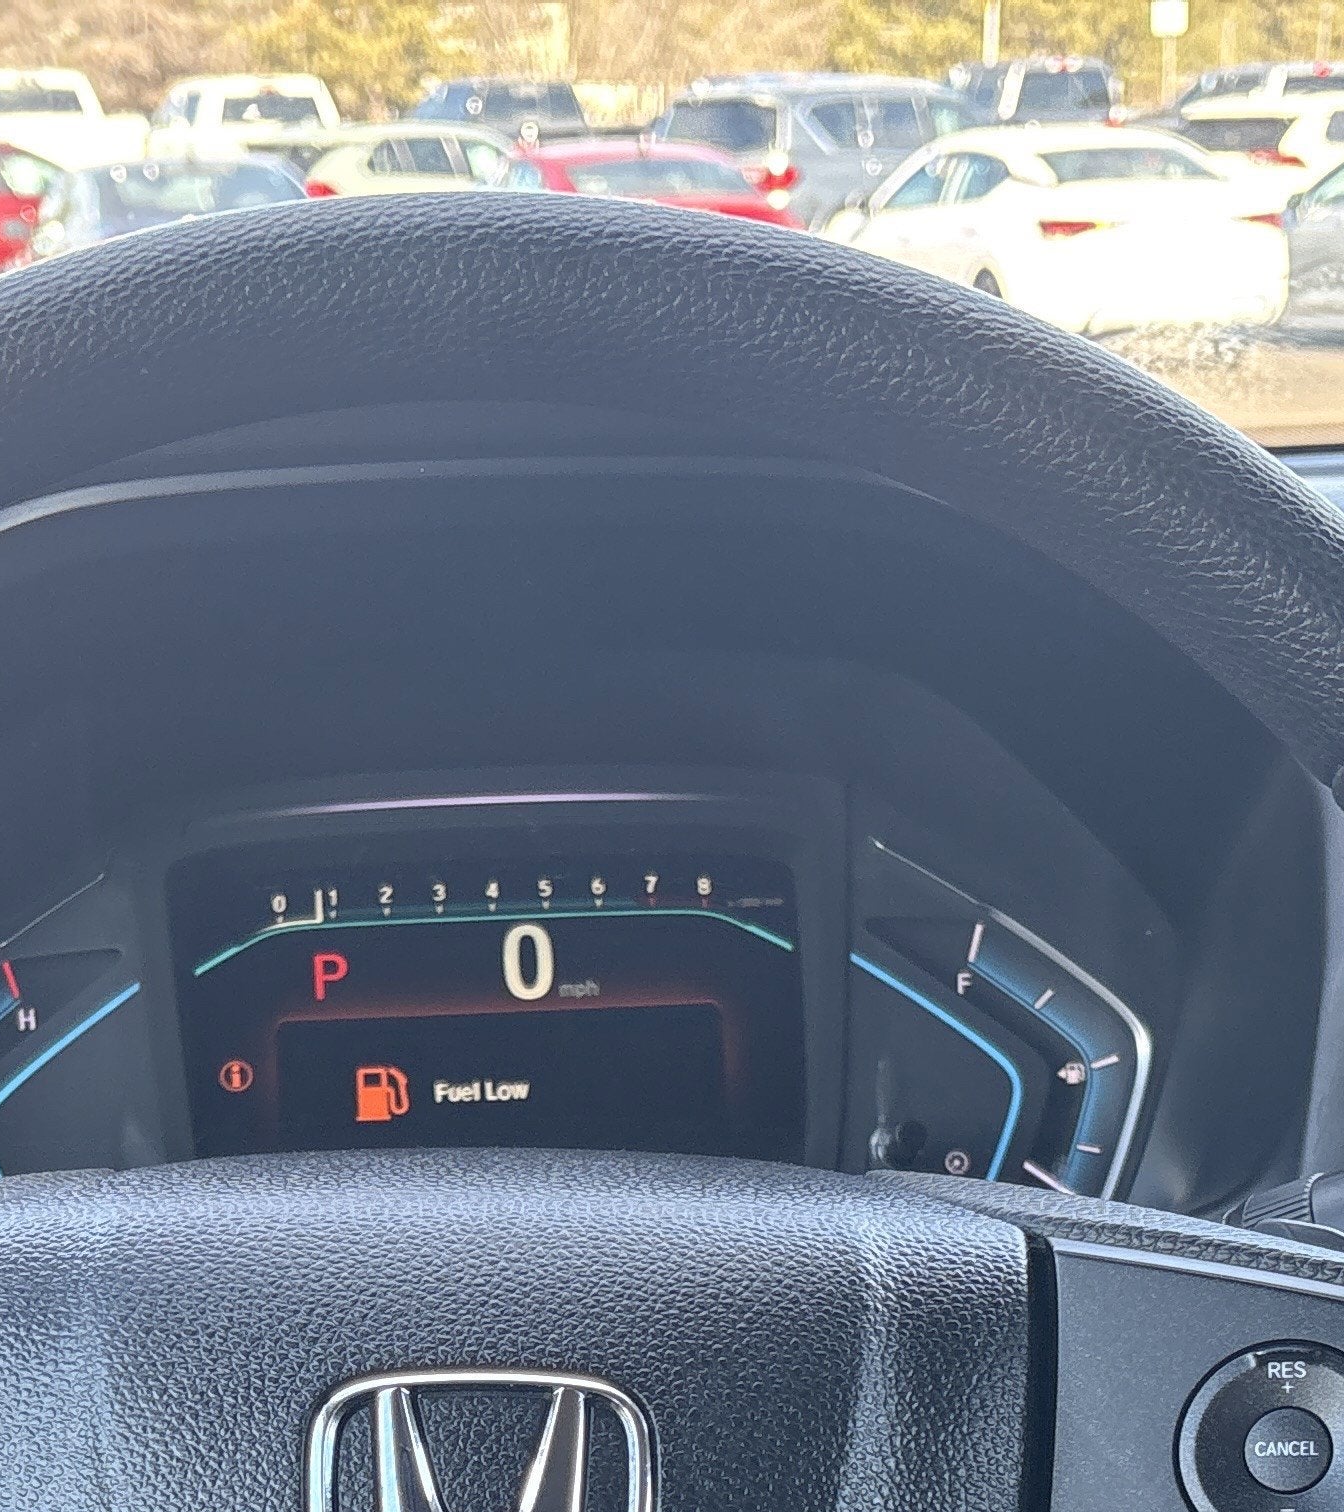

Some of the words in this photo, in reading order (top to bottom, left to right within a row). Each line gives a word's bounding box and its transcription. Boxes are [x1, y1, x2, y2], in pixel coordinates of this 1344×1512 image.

[327, 889, 338, 906] 1
[378, 885, 394, 904] 2
[431, 883, 447, 902] 3
[485, 880, 500, 899] 4
[537, 879, 553, 898] 5
[590, 876, 606, 896] 6
[644, 875, 659, 894] 7
[695, 876, 713, 896] 8
[502, 923, 555, 1001] 0
[312, 952, 349, 1001] P
[956, 971, 972, 995] F
[17, 1007, 36, 1032] H
[433, 1083, 480, 1103] Fuel
[484, 1080, 531, 1101] Low
[1267, 1360, 1307, 1379] RES
[1254, 1440, 1319, 1457] CANCEL
